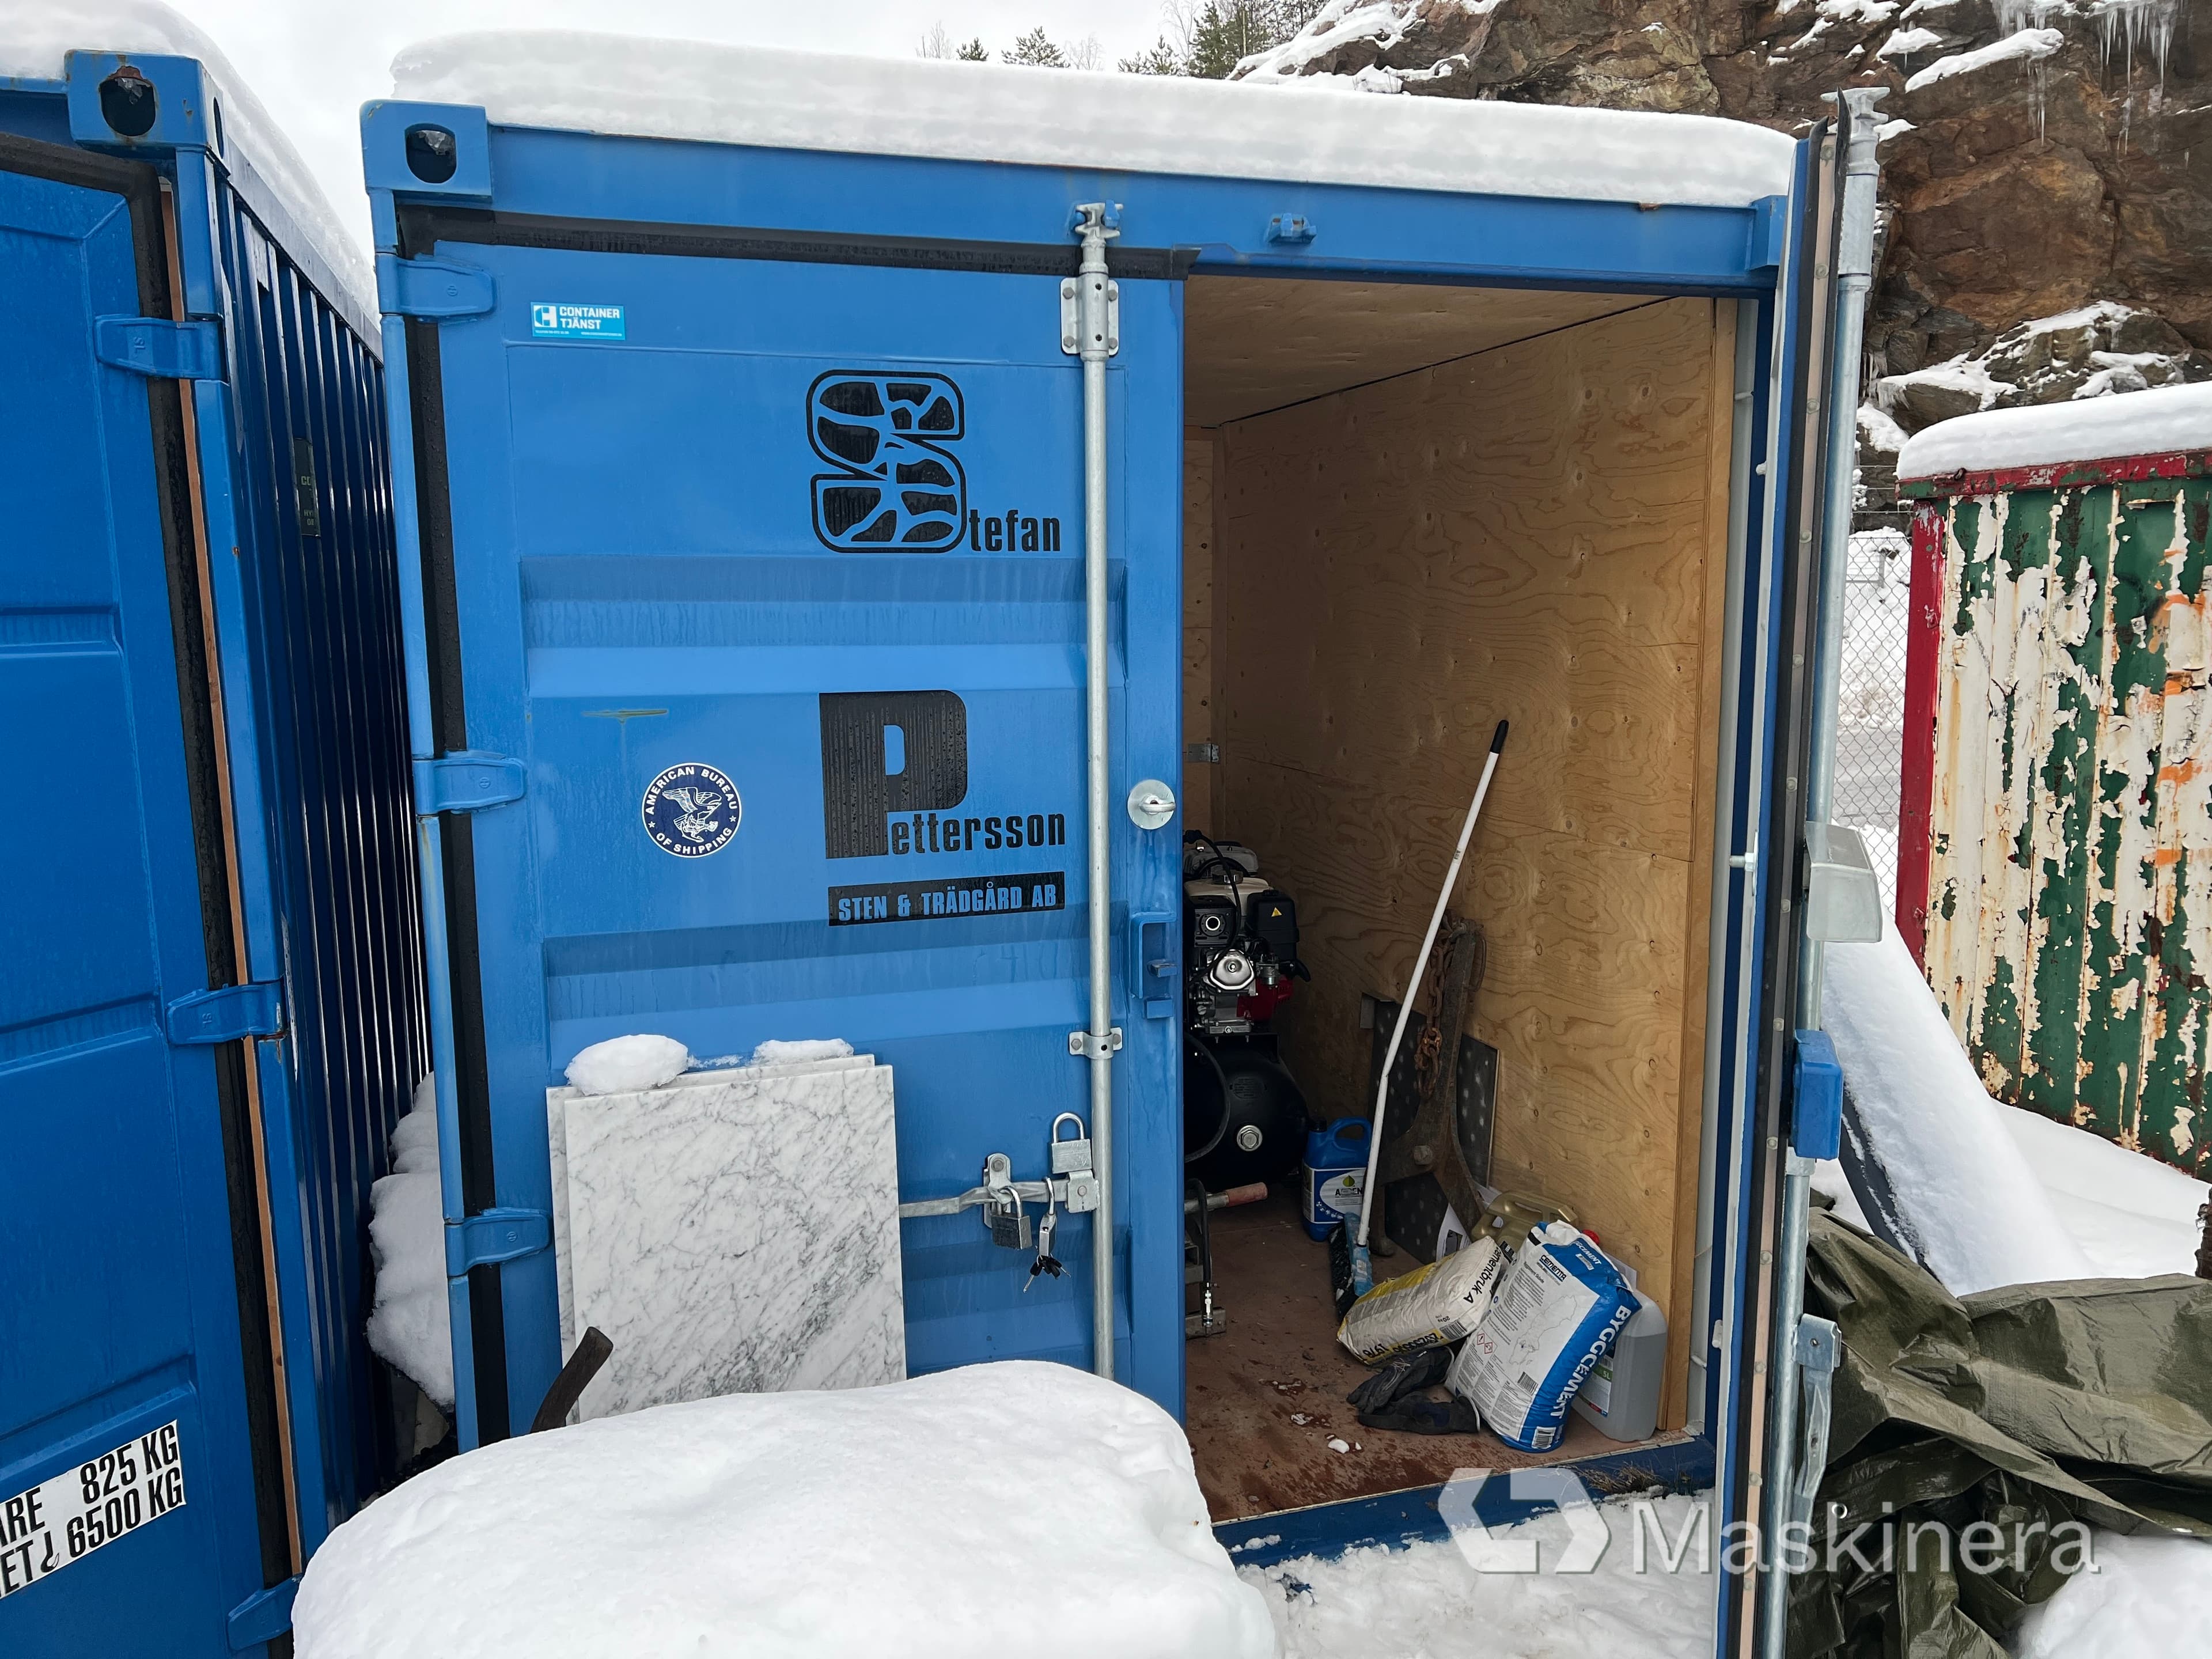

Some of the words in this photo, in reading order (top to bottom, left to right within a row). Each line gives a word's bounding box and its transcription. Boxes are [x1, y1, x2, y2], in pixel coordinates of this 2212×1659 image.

[559, 306, 620, 319] CONTAINER
[560, 317, 601, 329] TJÄNST
[646, 767, 695, 815] AMERICAN
[700, 768, 737, 809] BUREAU
[819, 690, 1066, 859] Pettersson
[656, 832, 672, 846] OF
[673, 827, 733, 855] SHIPPING
[838, 896, 888, 921] STEN
[897, 895, 911, 917] &
[921, 881, 1022, 915] TRÄDGÅRD
[1032, 884, 1056, 907] AB
[1539, 1254, 1567, 1281] CEMENTA
[1463, 1295, 1474, 1304] A
[1550, 1305, 1632, 1419] BYGGCEMENT
[79, 1443, 137, 1505] 825
[141, 1424, 179, 1475] KG
[0, 1539, 34, 1599] ET
[66, 1488, 141, 1558] 6500
[147, 1467, 183, 1519] KG
